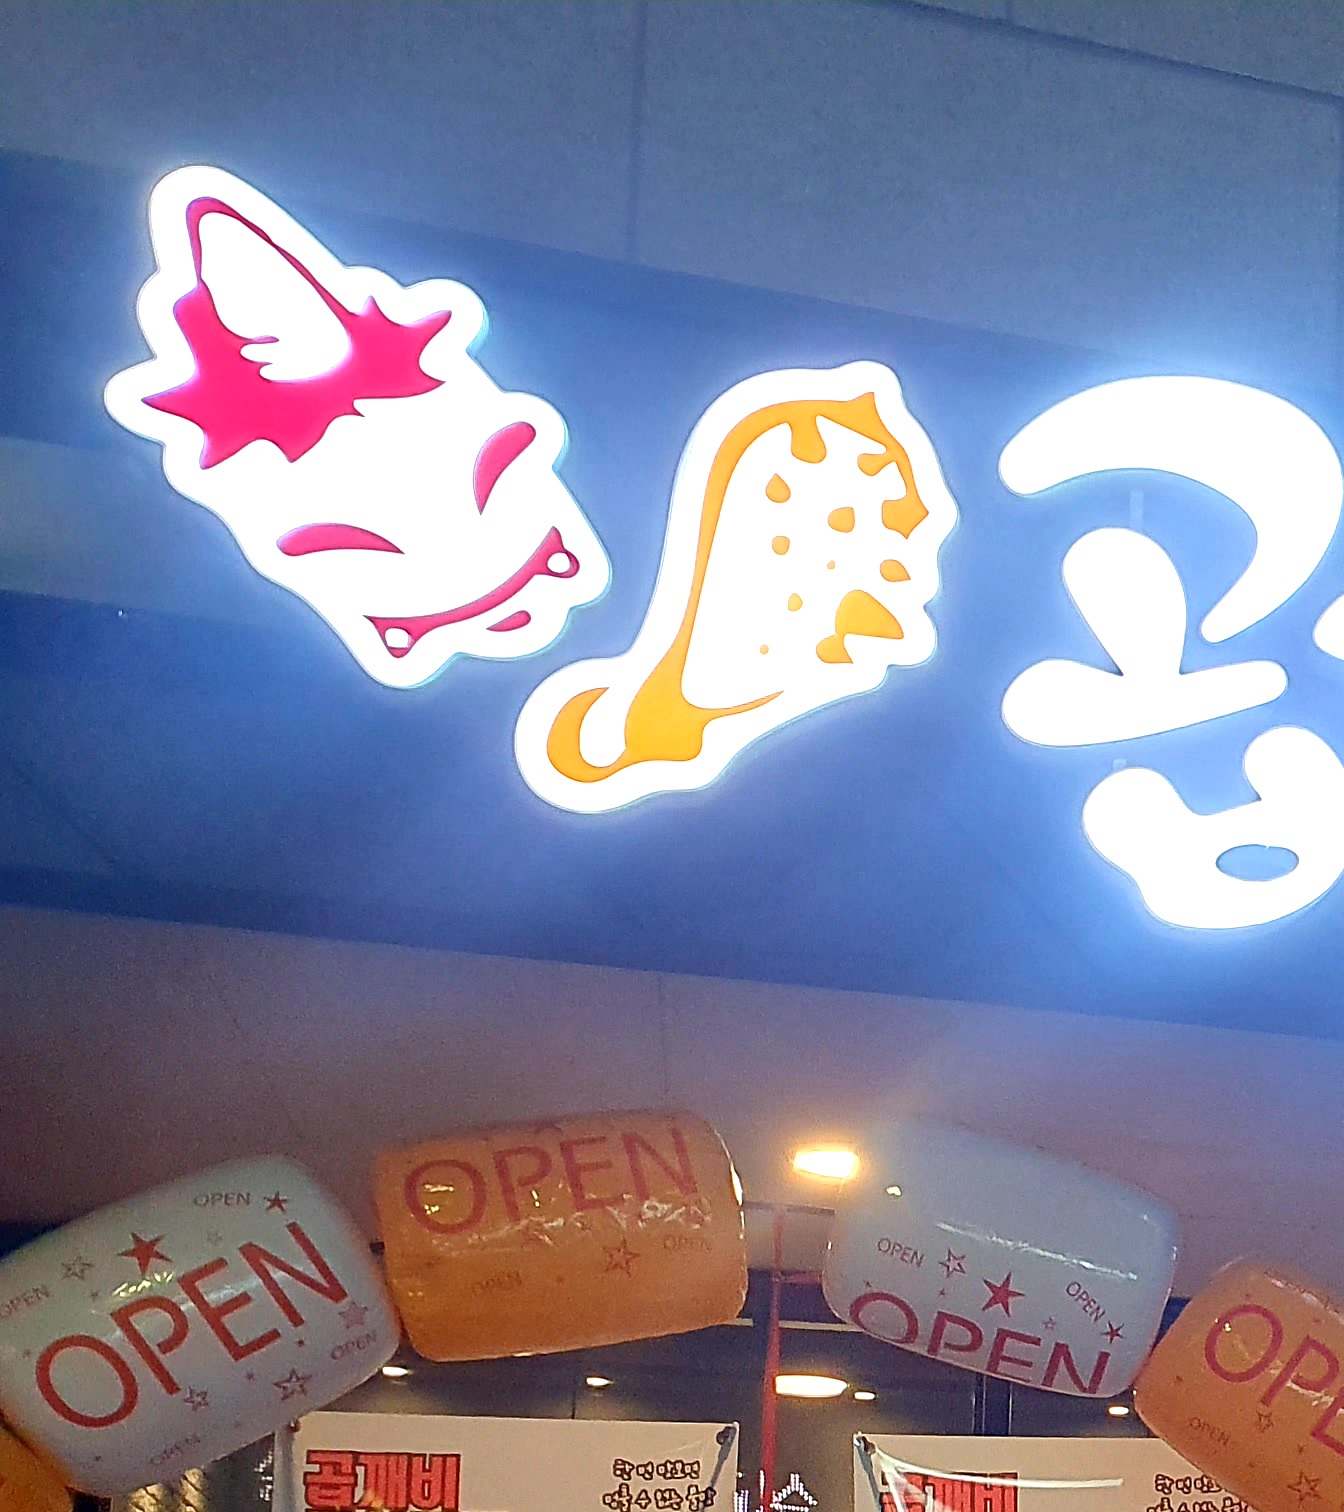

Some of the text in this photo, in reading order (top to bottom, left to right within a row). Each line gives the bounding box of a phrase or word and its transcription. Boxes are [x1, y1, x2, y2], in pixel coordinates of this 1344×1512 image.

[192, 1191, 251, 1207] OPEN
[404, 1127, 697, 1236] OPEN
[877, 1238, 924, 1267] OPEN
[35, 1222, 348, 1429] OPEN
[1066, 1282, 1105, 1323] OPEN
[329, 1331, 378, 1360] OPEN
[849, 1291, 1112, 1396] OPEN
[304, 1451, 460, 1511] 곱깨비
